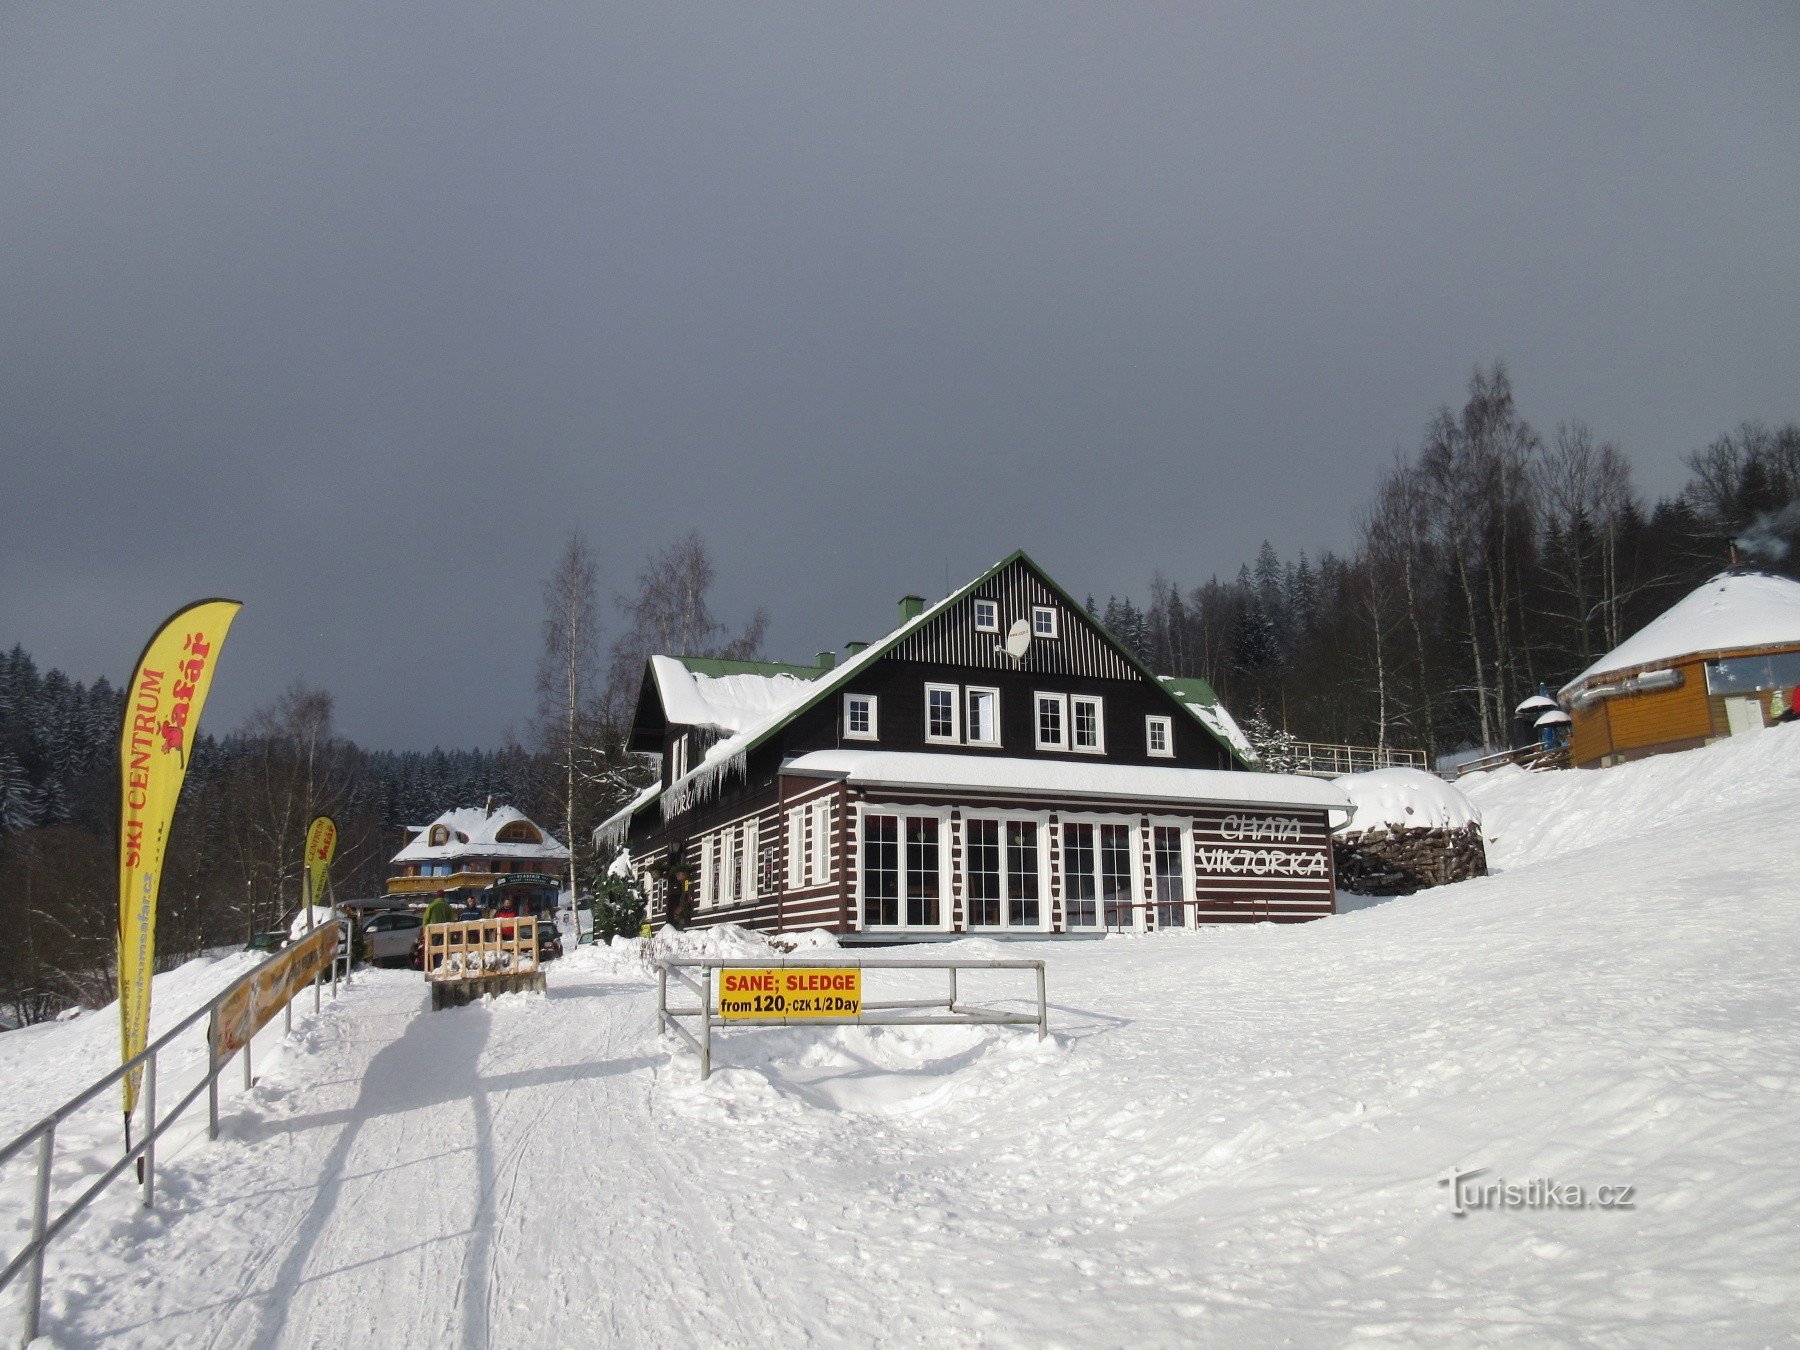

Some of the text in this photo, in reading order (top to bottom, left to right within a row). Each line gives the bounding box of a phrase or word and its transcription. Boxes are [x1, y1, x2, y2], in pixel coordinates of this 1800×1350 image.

[126, 668, 164, 868] SKI CENTRUM
[1220, 814, 1301, 842] CHATA
[1198, 847, 1325, 876] VIKTORKA
[786, 975, 856, 991] SLEDGE
[721, 998, 751, 1012] from
[792, 999, 811, 1012] CZK
[814, 997, 833, 1012] 1/2
[835, 997, 859, 1013] Day
